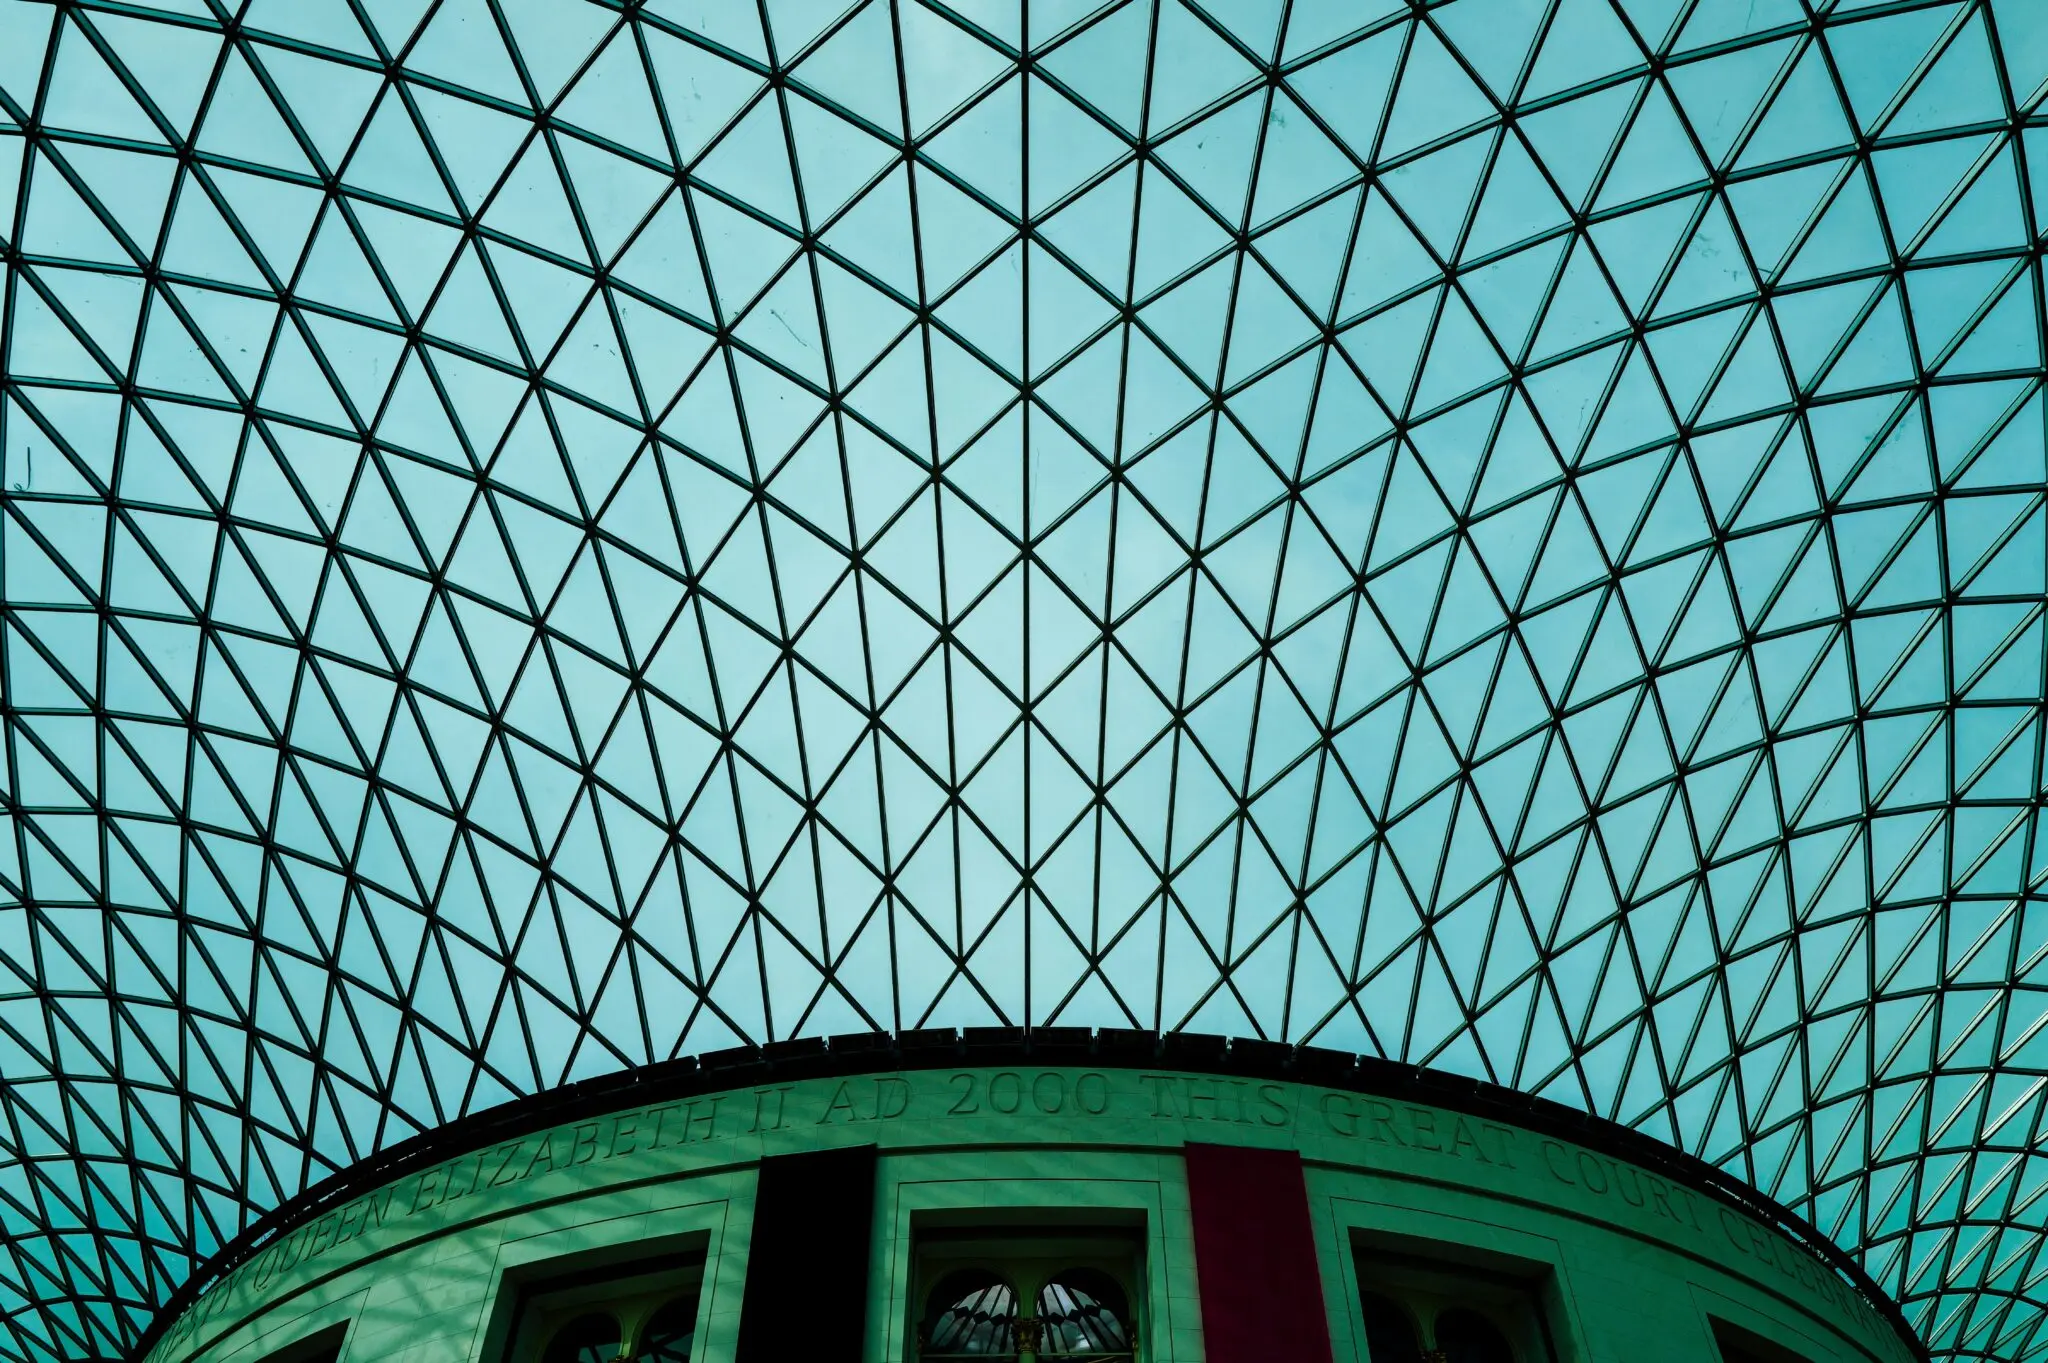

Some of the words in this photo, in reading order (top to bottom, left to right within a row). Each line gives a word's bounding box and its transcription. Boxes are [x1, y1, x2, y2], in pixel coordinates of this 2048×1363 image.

[253, 1184, 399, 1292] QUEEN
[406, 1098, 721, 1217] ELIZABETH
[746, 1086, 796, 1134] II
[815, 1077, 912, 1125] AD
[947, 1072, 1110, 1116] 2000
[1138, 1074, 1290, 1128] THIS
[1320, 1092, 1517, 1170] GREAT
[1540, 1138, 1704, 1233] COURT
